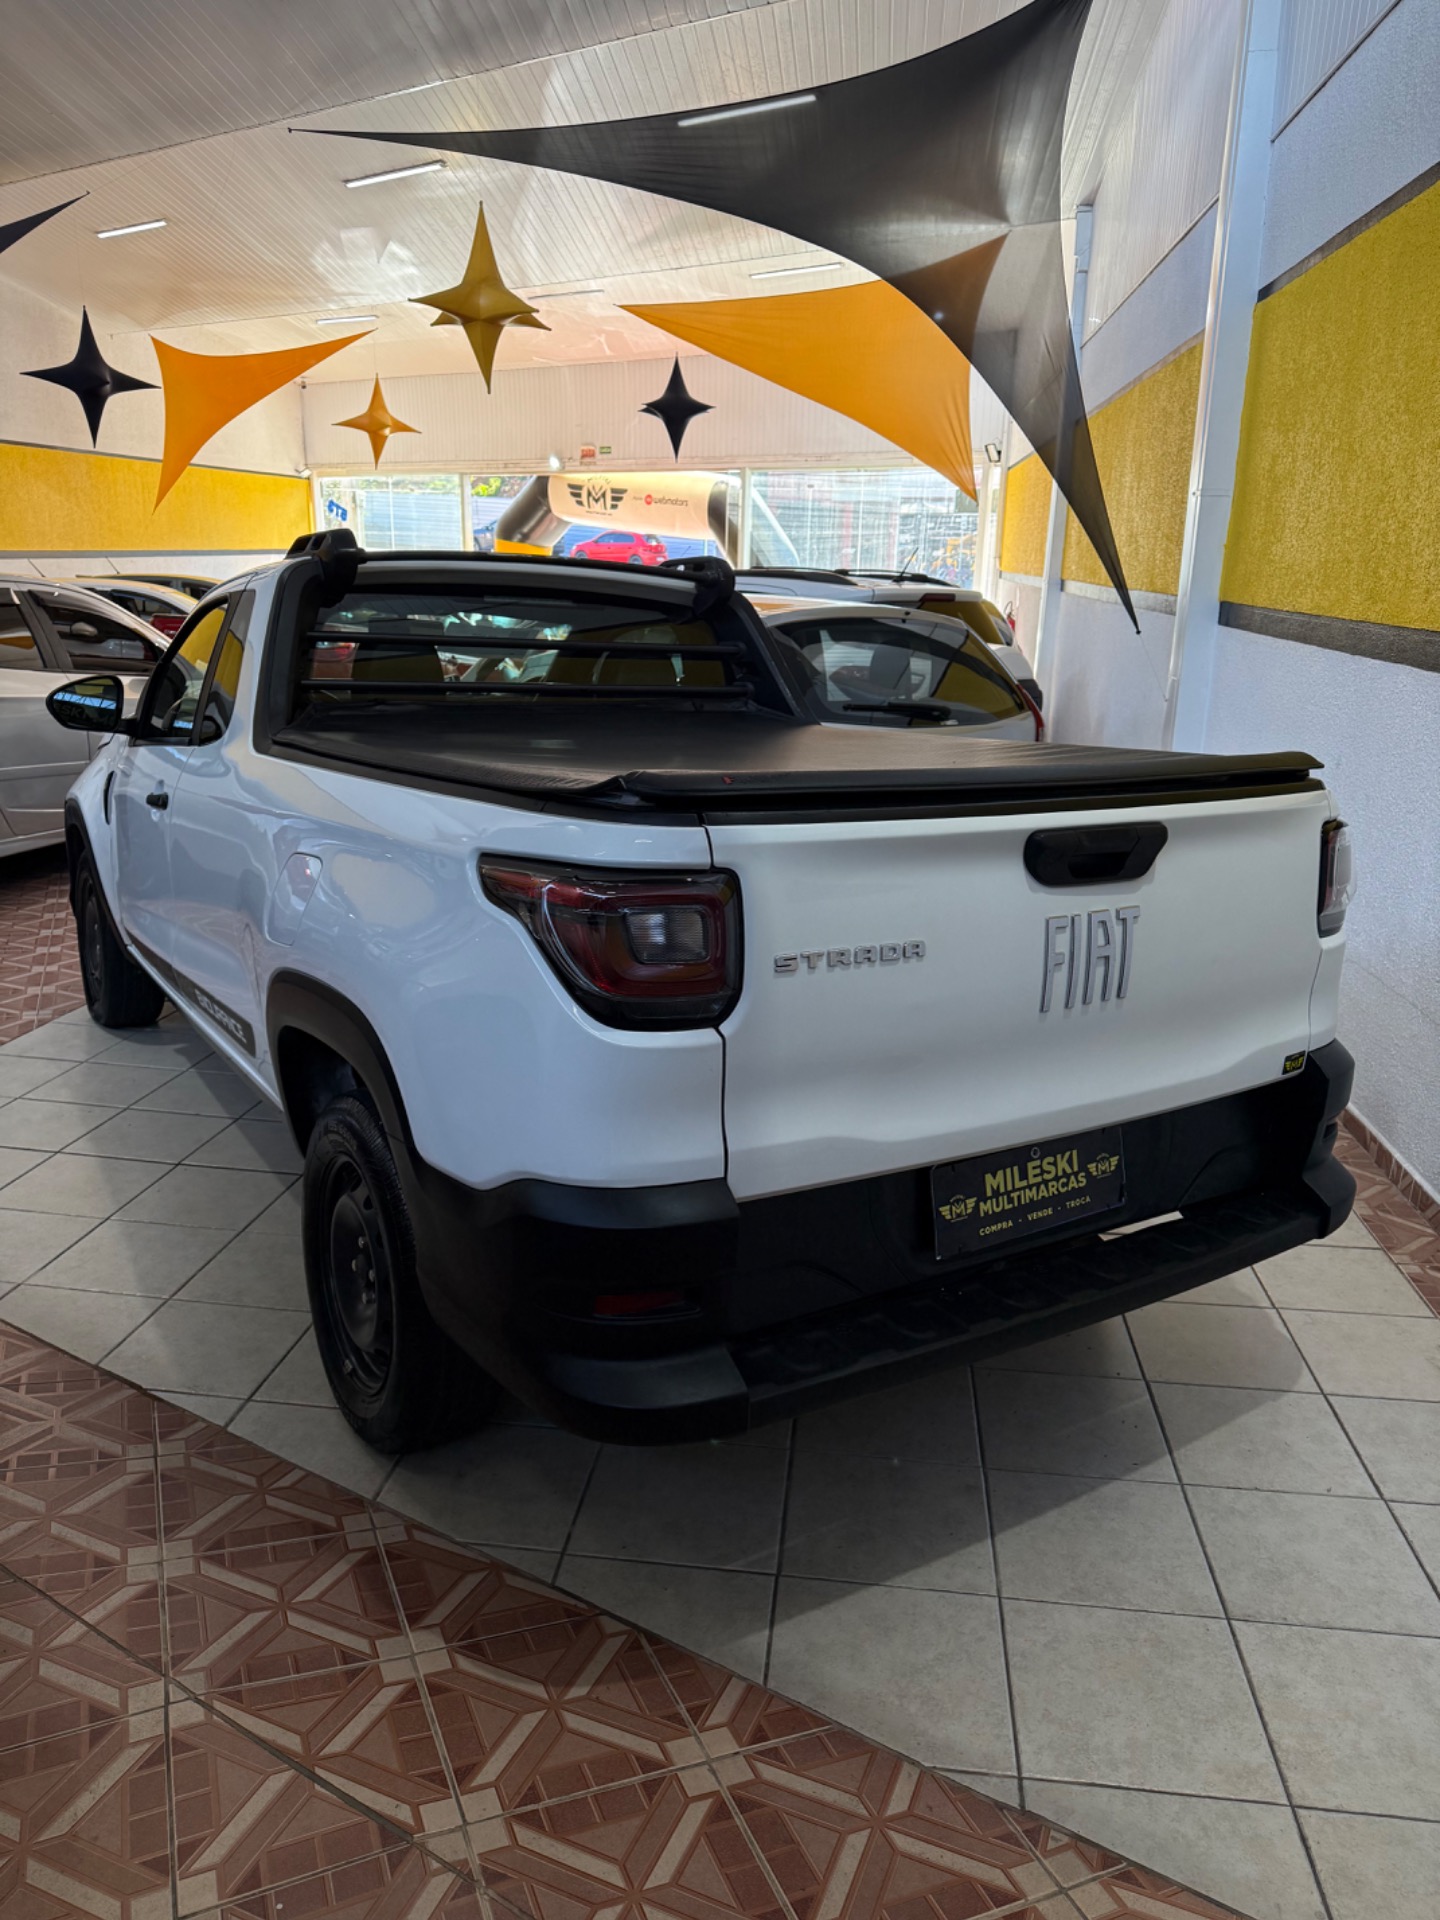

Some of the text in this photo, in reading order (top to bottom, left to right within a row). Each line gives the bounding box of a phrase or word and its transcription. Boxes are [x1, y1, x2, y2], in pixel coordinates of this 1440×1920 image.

[774, 940, 926, 973] STRADA
[1040, 905, 1140, 1012] FIAT
[979, 1173, 1087, 1217] MULTIMARCAS
[984, 1150, 1079, 1197] MILESKI
[979, 1195, 1091, 1236] COMPRA VENDE TROCA
